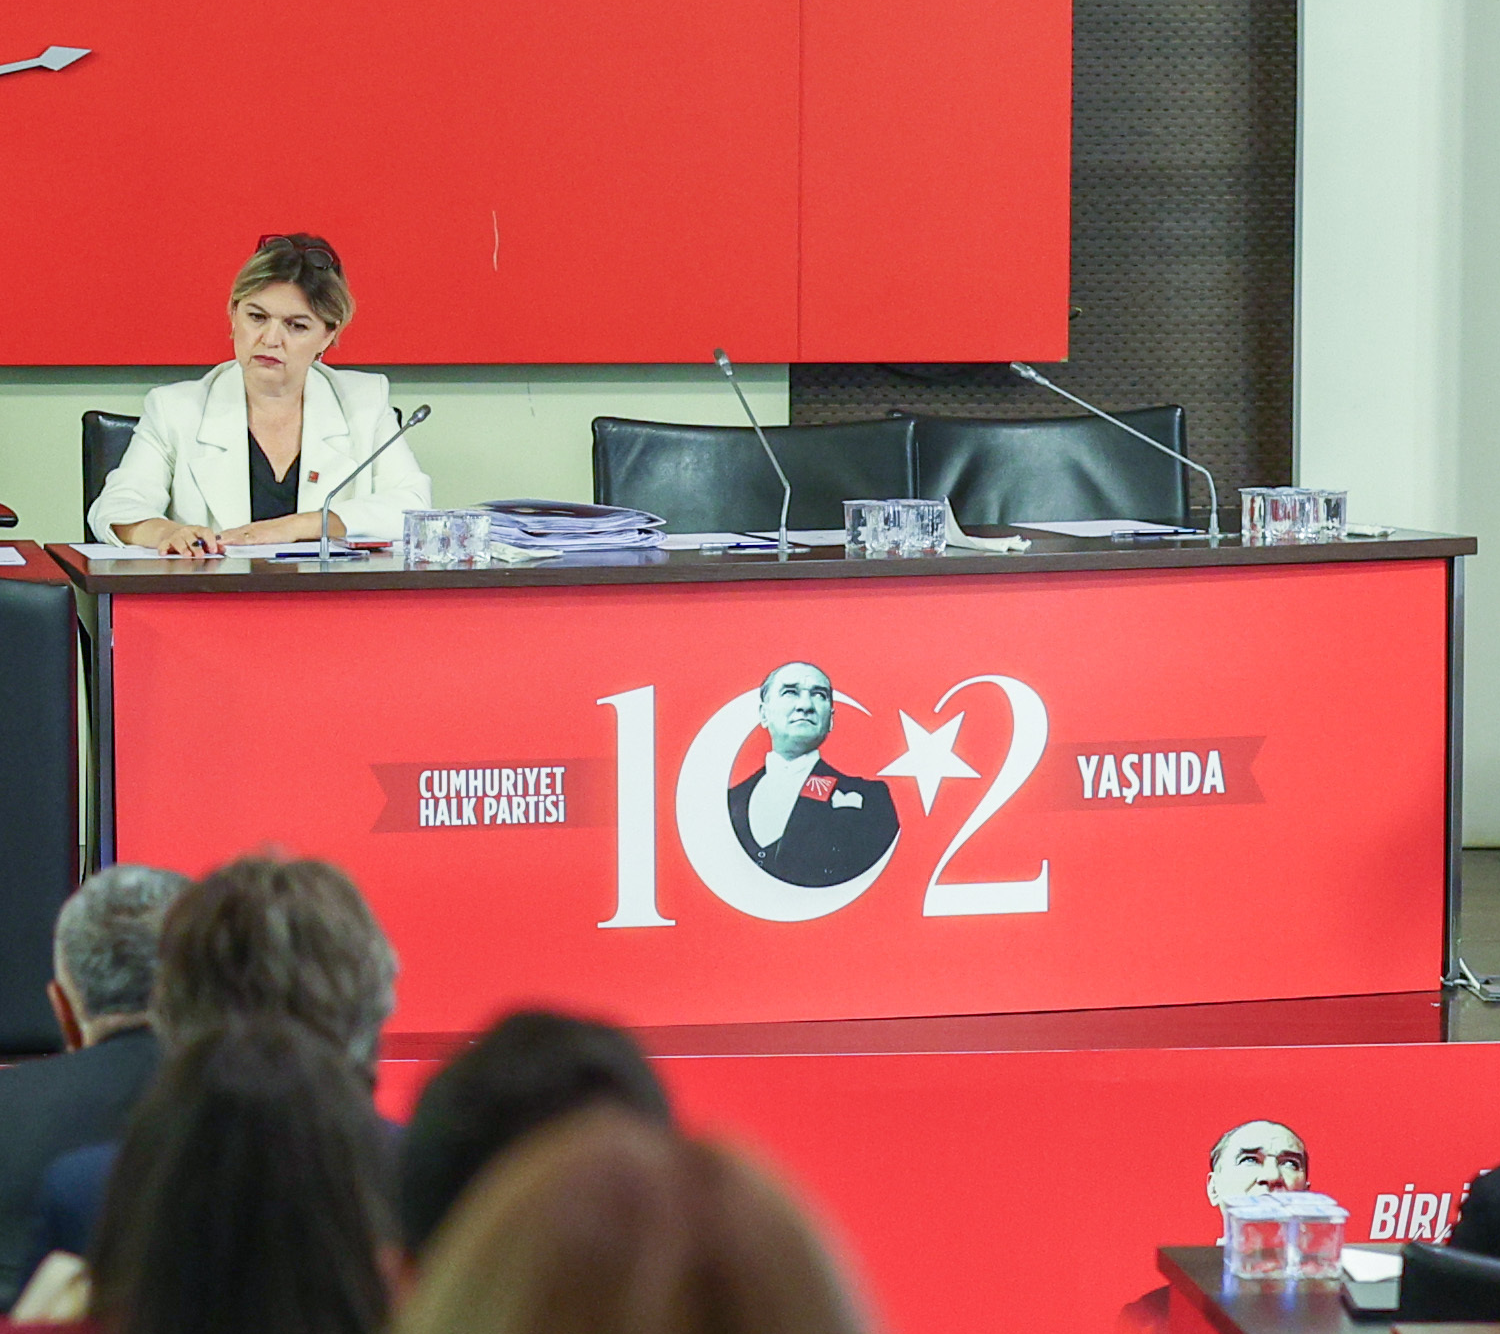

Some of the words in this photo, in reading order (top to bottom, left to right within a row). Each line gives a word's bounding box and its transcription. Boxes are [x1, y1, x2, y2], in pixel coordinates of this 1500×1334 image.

[419, 766, 566, 798] CUMHURİYET
[1076, 750, 1225, 804] YAŞINDA
[419, 797, 478, 827] HALK
[483, 795, 565, 825] PARTİSİ
